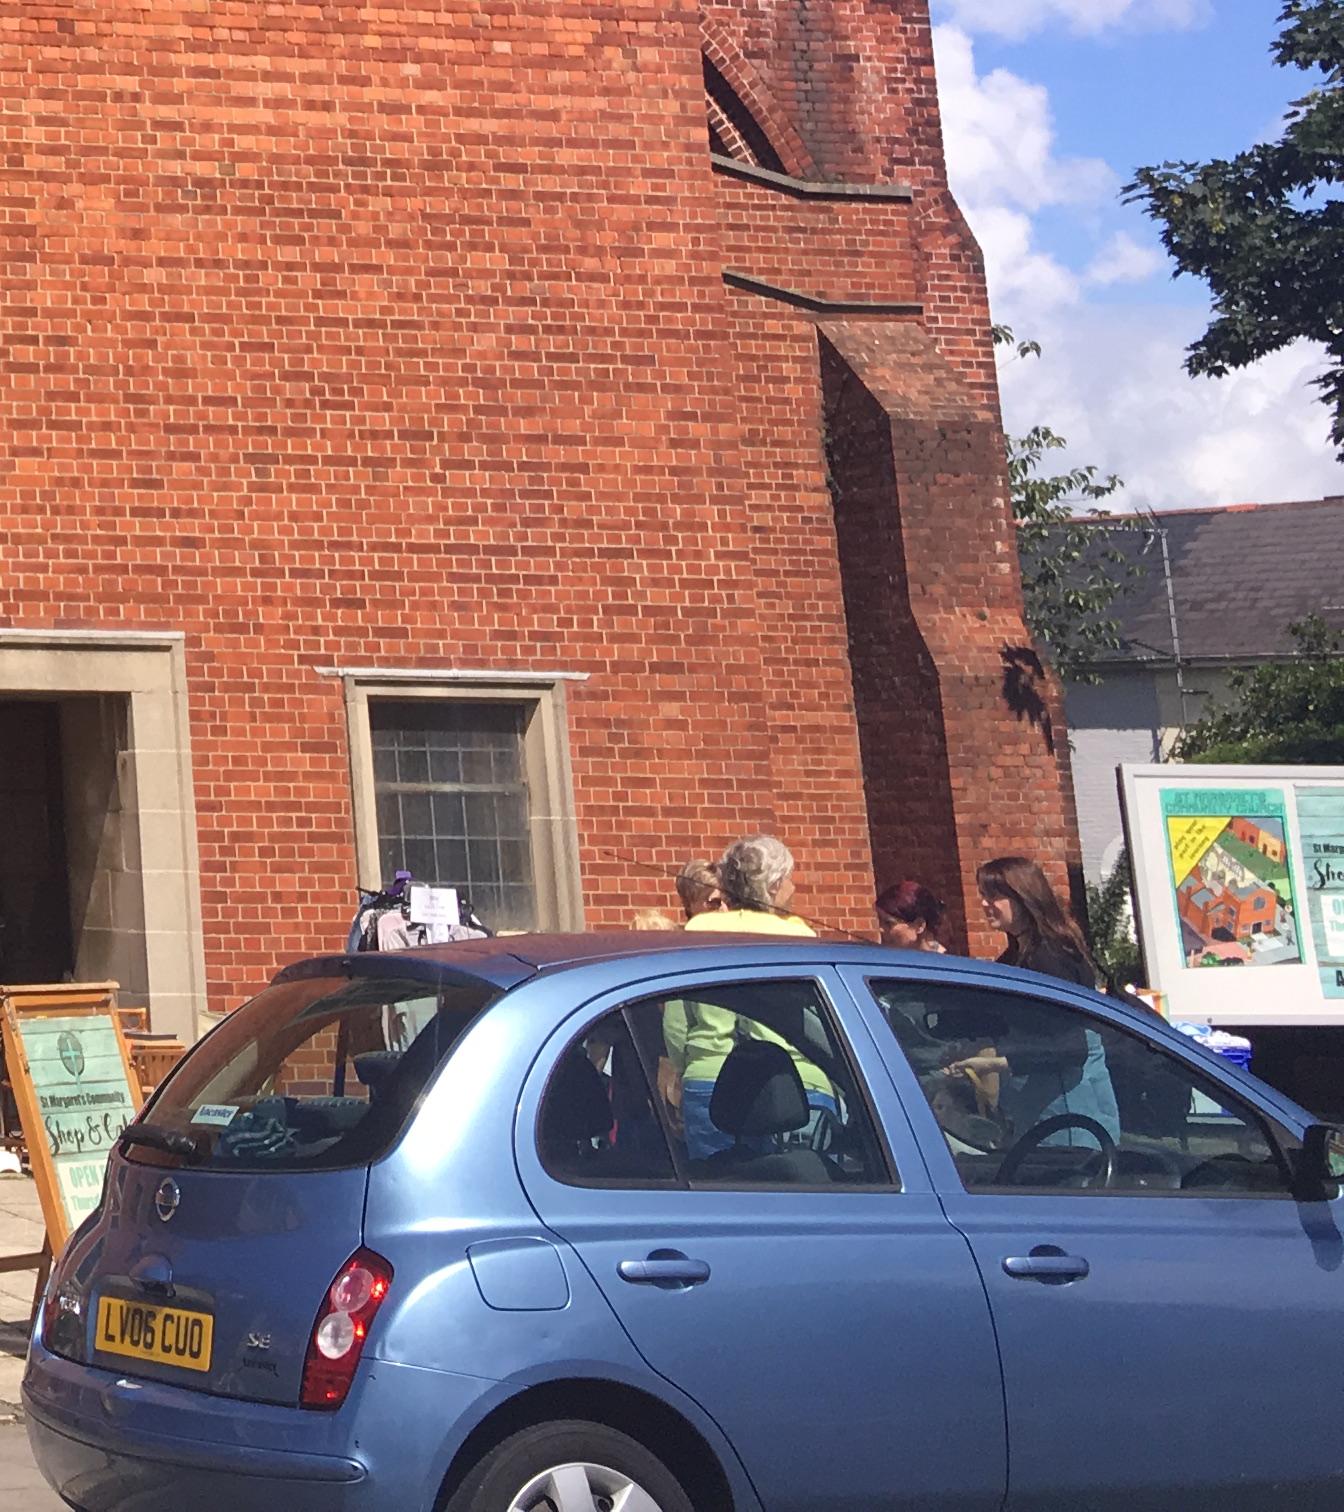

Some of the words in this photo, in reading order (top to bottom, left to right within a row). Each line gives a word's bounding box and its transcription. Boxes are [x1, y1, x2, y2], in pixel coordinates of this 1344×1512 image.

[1323, 843, 1344, 854] Marg
[1312, 858, 1344, 890] Sho
[40, 1095, 50, 1108] St
[49, 1093, 86, 1109] Margaret's
[86, 1090, 125, 1105] Community
[45, 1115, 85, 1157] Shop
[86, 1115, 102, 1146] &
[101, 1112, 129, 1142] Caf
[69, 1165, 100, 1188] OPEN
[70, 1193, 100, 1211] Thursd
[104, 1302, 157, 1351] LV06
[161, 1313, 204, 1359] CUO
